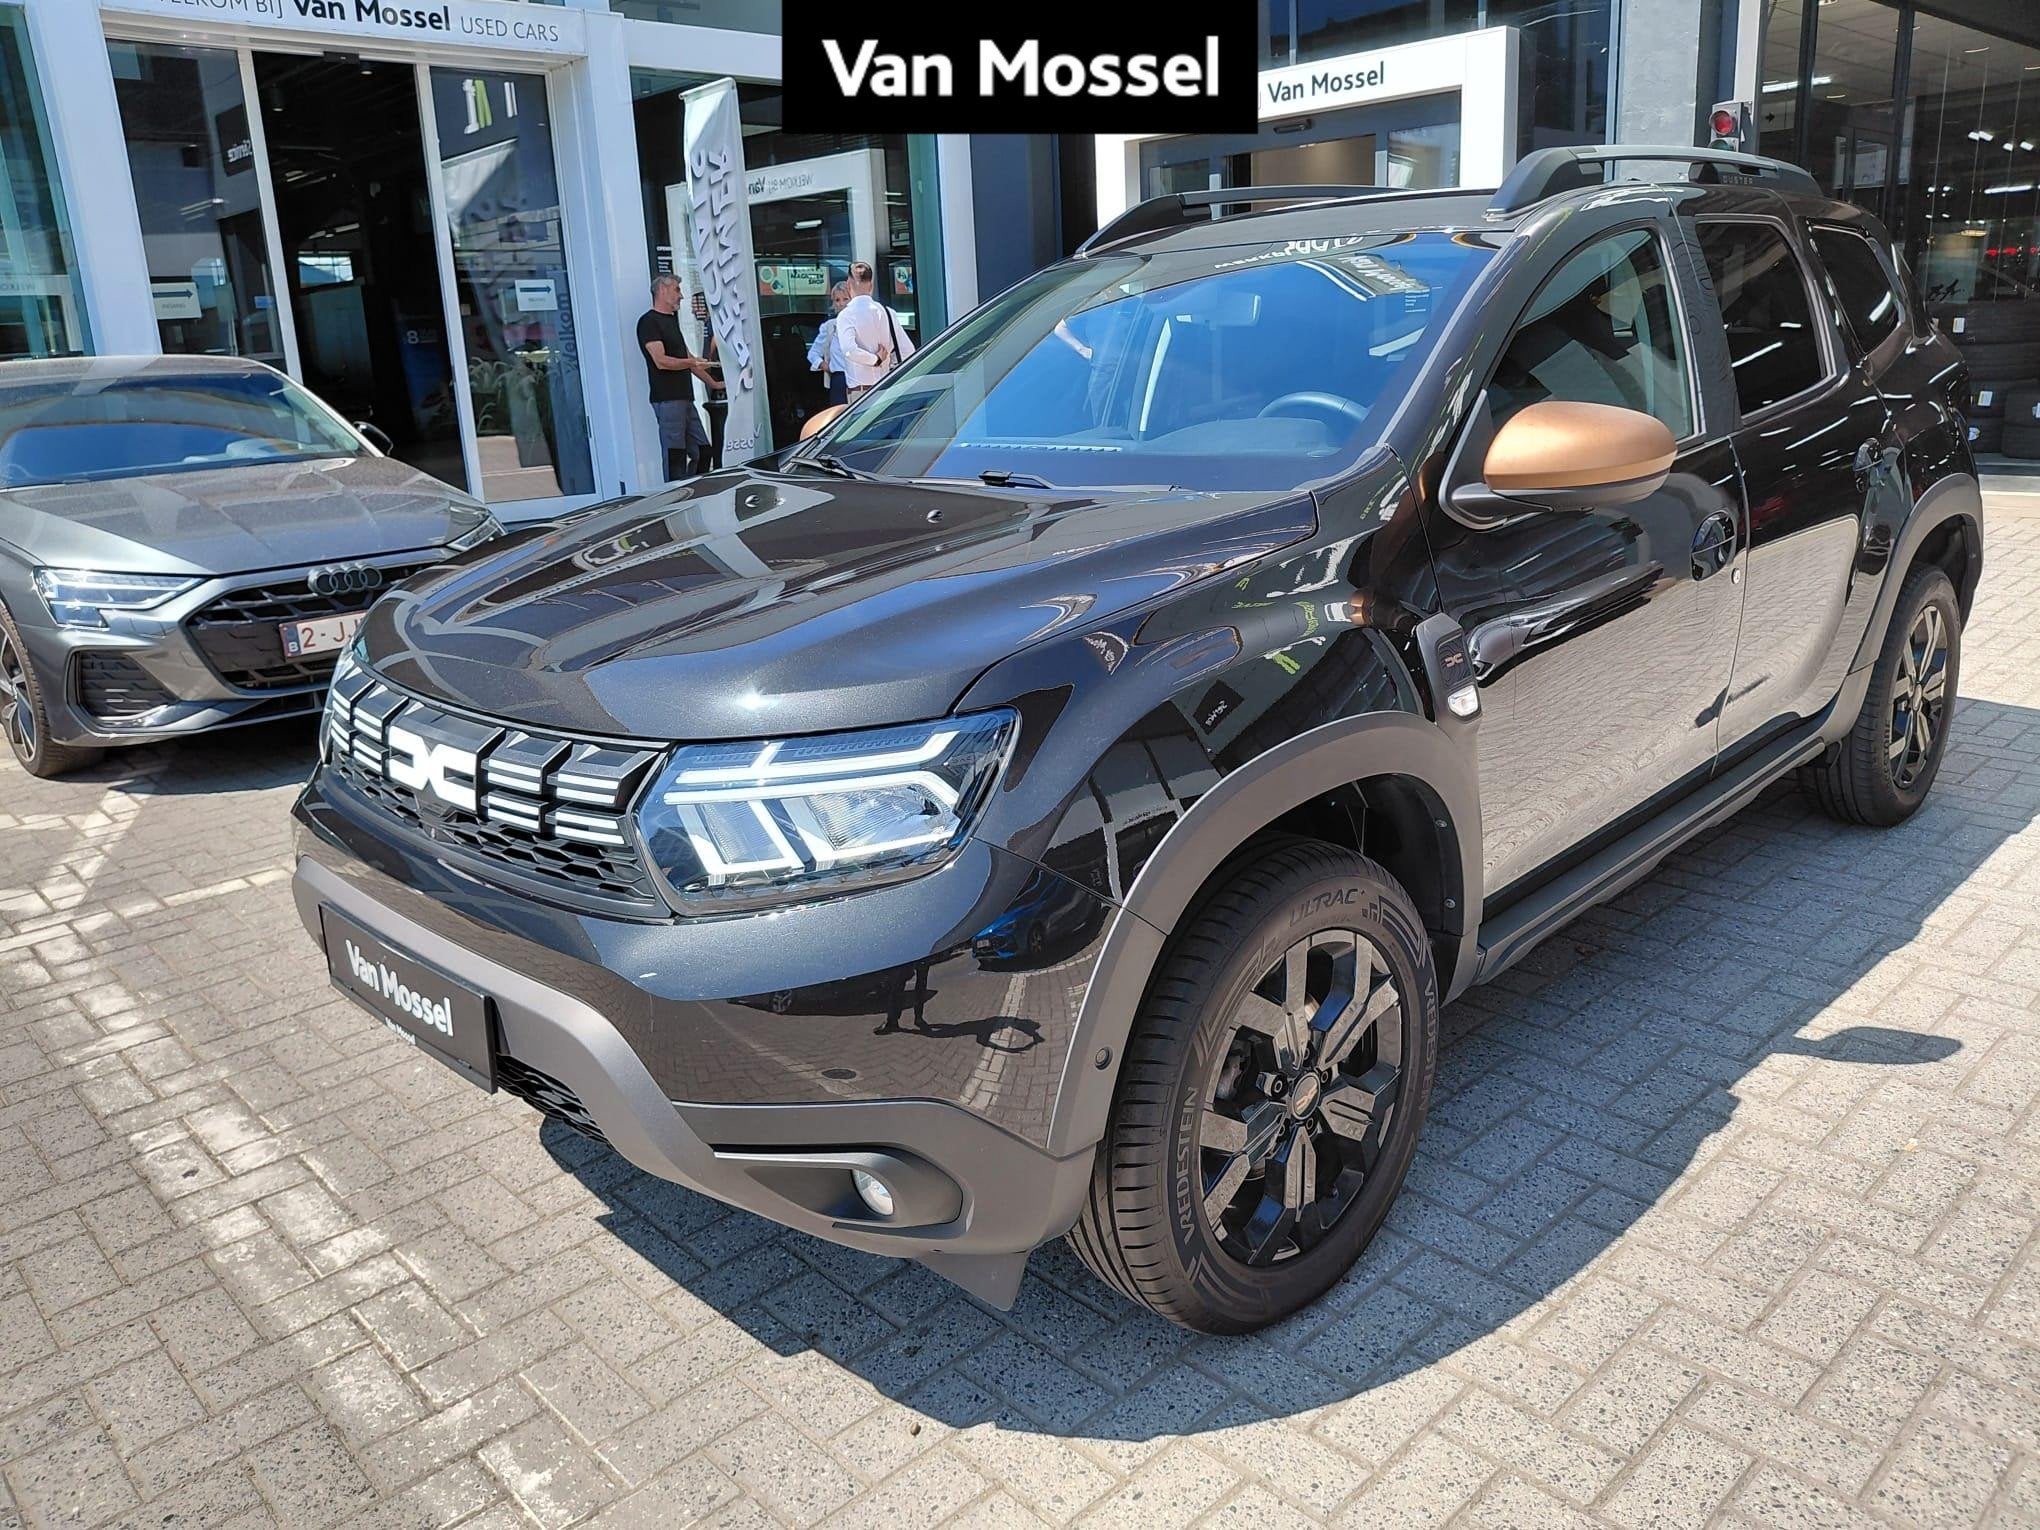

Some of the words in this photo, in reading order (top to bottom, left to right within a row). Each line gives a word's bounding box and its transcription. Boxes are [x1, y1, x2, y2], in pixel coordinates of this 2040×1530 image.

[294, 0, 345, 21] Van
[355, 0, 450, 31] Mossel
[460, 17, 508, 37] USED
[513, 22, 559, 42] CARS
[1267, 81, 1304, 103] Van
[1311, 60, 1384, 97] Mossel
[287, 641, 299, 653] B
[1289, 887, 1359, 928] ULTRAC
[345, 939, 380, 992] Van
[380, 963, 454, 1038] Mossel
[1176, 1086, 1199, 1246] VREDESTEIN
